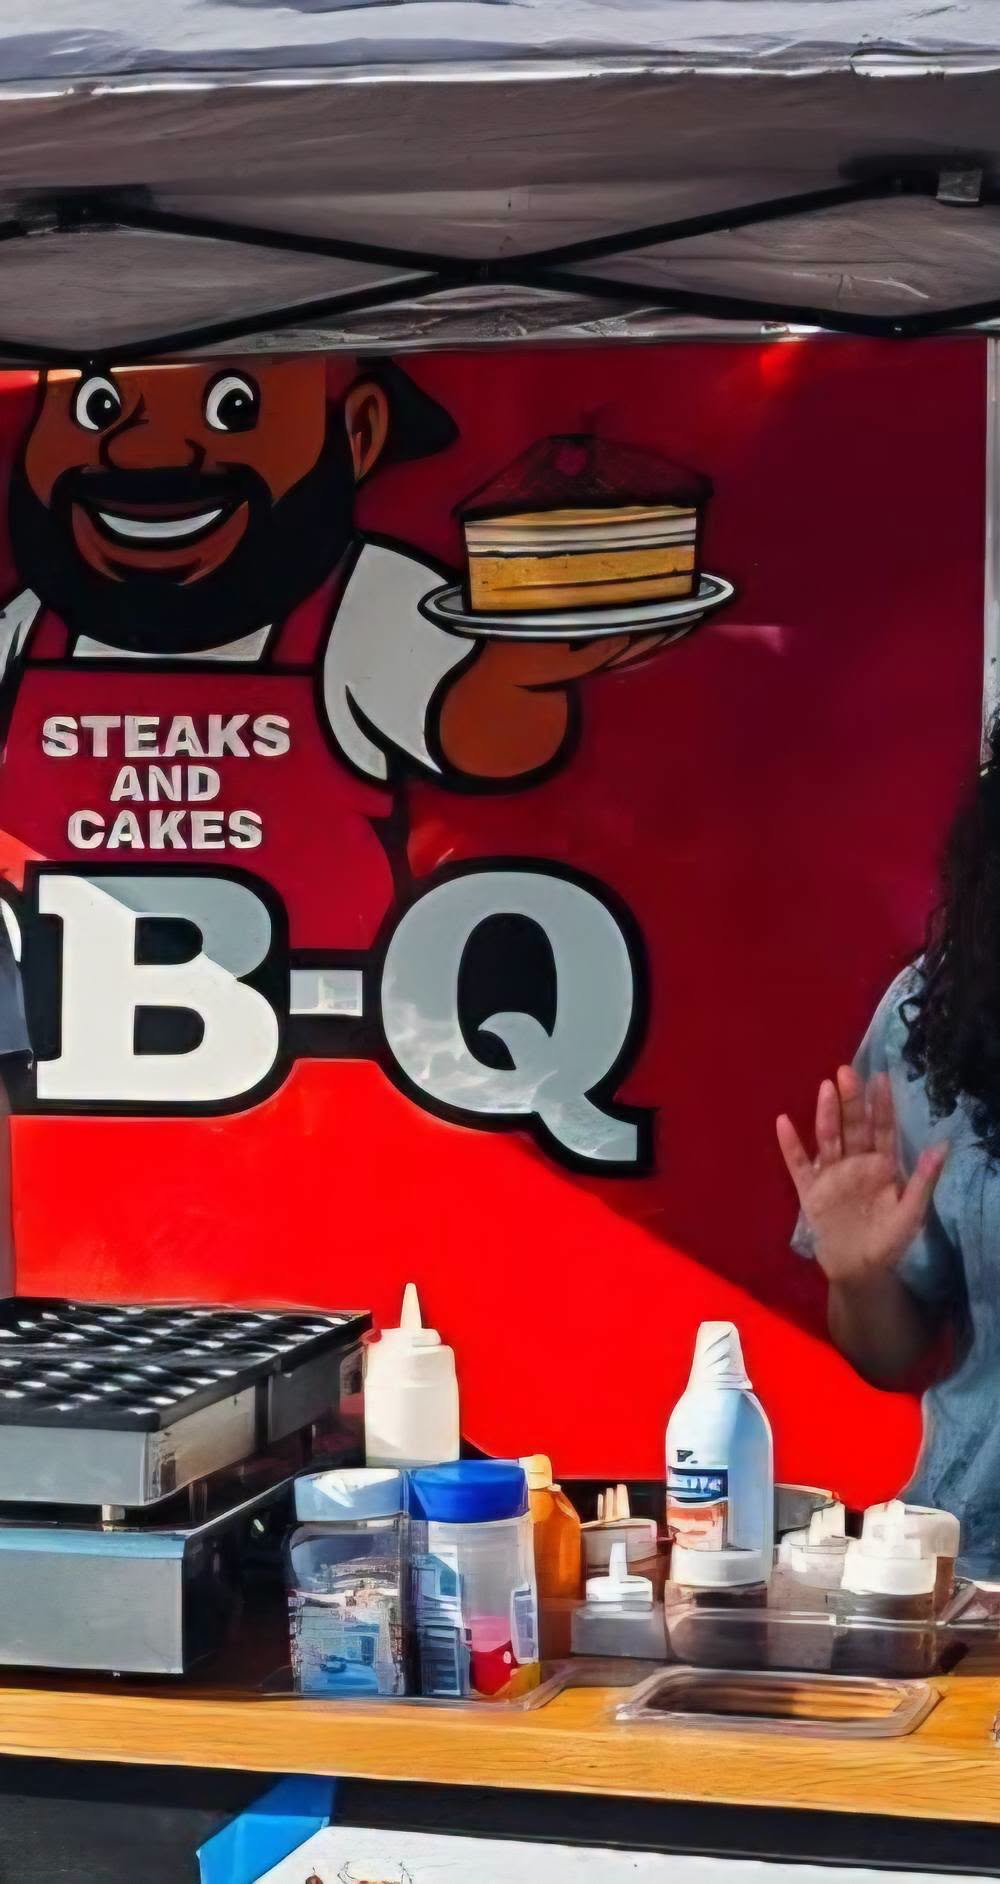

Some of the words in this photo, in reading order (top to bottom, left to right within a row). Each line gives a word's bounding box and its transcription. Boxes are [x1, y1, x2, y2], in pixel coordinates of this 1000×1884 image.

[41, 714, 291, 758] STEAKS
[109, 765, 221, 802] AND
[67, 809, 264, 849] CAKES
[0, 873, 638, 1163] B-Q
